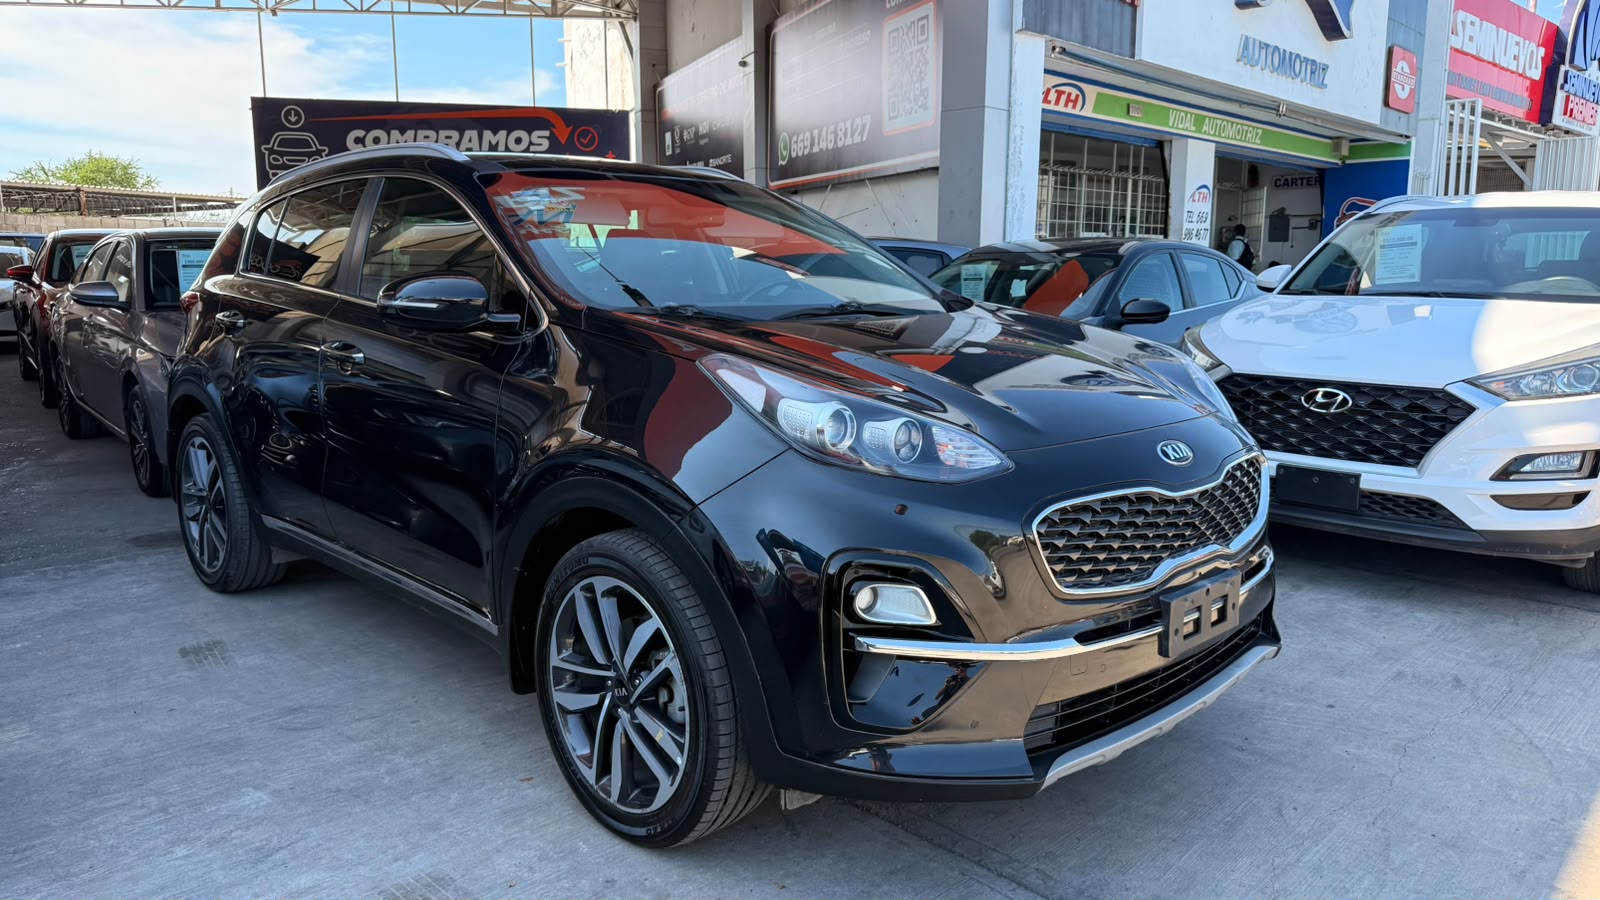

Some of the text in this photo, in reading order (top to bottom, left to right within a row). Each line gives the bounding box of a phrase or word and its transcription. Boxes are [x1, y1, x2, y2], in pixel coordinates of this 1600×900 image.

[1450, 9, 1545, 81] SEMINUEVOS
[1236, 34, 1329, 89] AUTOMOTRIZ
[1042, 86, 1081, 110] LTH
[790, 115, 872, 159] 669.146.8127
[1168, 109, 1196, 131] VIDAL
[1202, 116, 1263, 144] AUTOMOTRIZ
[346, 128, 550, 152] COMPRAMOS
[1191, 191, 1209, 203] LTH
[1162, 443, 1191, 460] KIA
[614, 687, 628, 697] KIA
